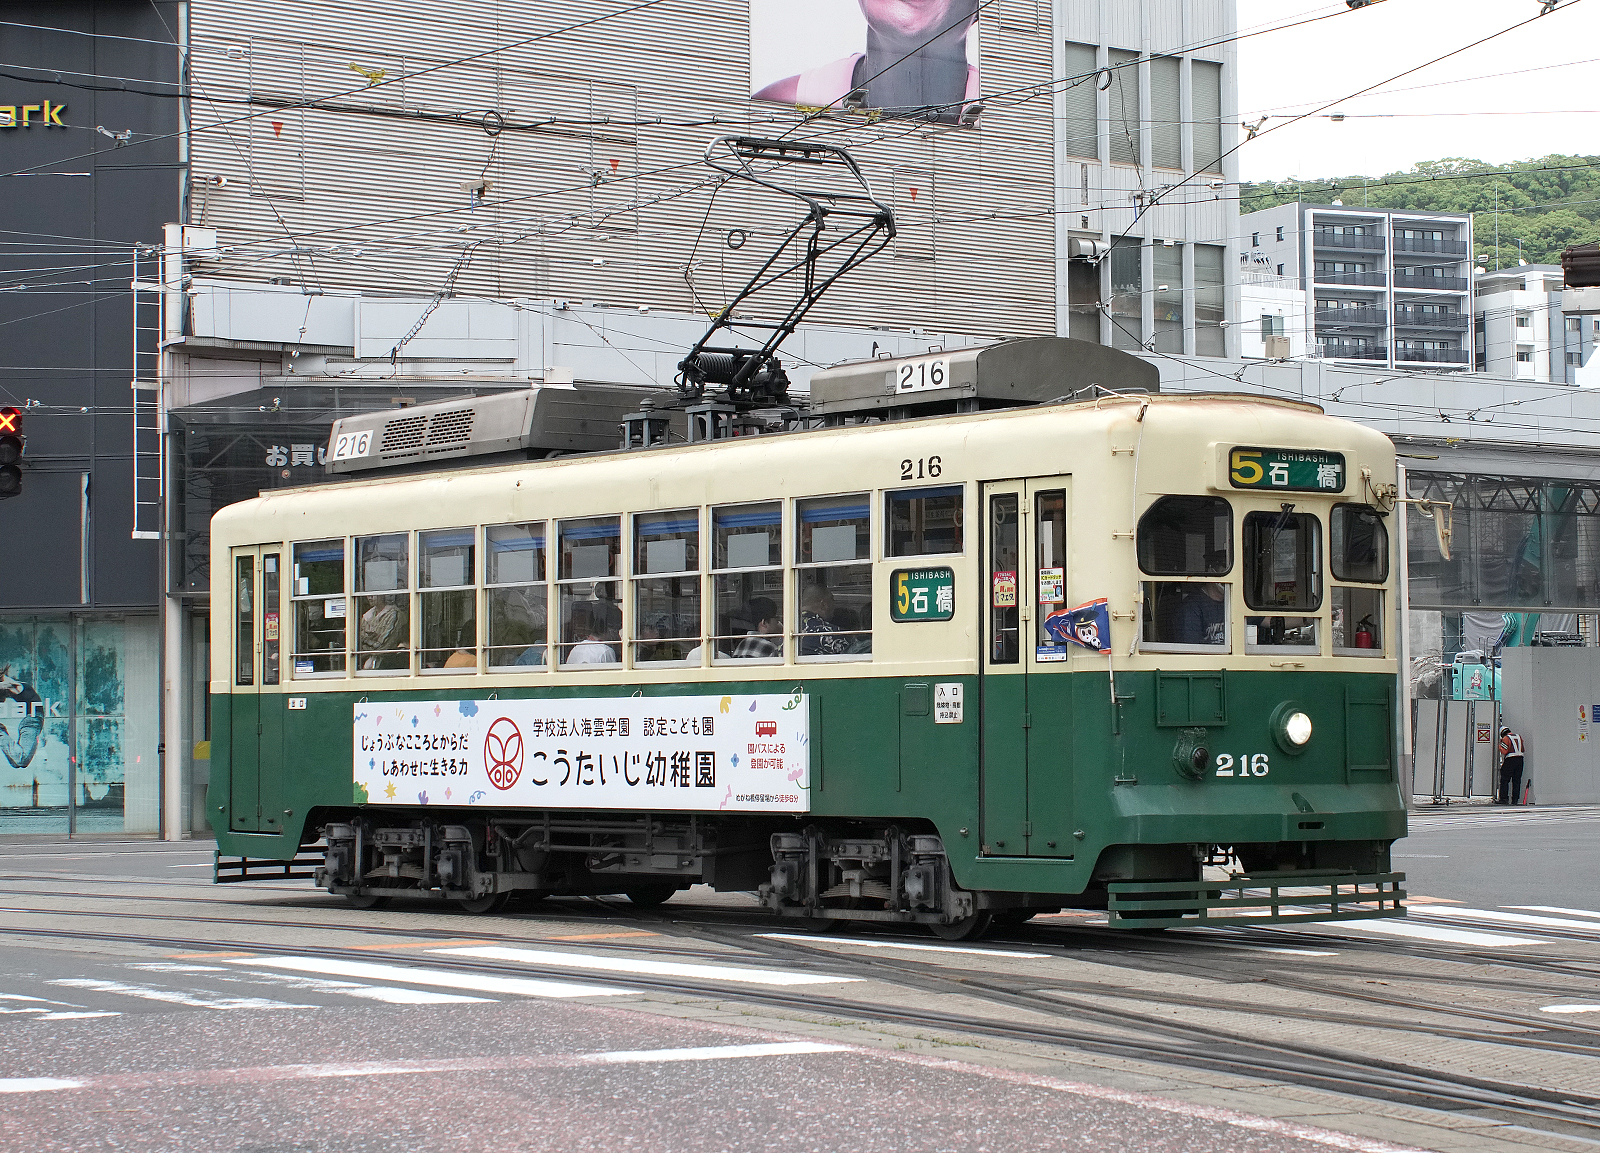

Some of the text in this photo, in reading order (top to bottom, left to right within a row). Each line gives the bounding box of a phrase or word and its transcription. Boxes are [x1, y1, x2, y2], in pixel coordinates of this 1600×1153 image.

[900, 360, 944, 390] 216
[336, 433, 369, 457] 216
[900, 455, 942, 481] 216
[1277, 453, 1328, 463] ISHIBASHI
[1231, 451, 1337, 489] 5 石橋
[897, 572, 953, 615] 5 石橋
[939, 687, 958, 697] 入口
[532, 716, 715, 738] 学校法人海雲学園 認定こども園
[361, 732, 469, 752] じょうぶなこころとからだ
[747, 743, 786, 755] 園バスによる
[381, 757, 469, 777] しあわせに生きる力
[531, 749, 716, 788] こうたいじ幼稚園
[750, 757, 784, 770] 登園が可能
[1215, 753, 1269, 777] 216
